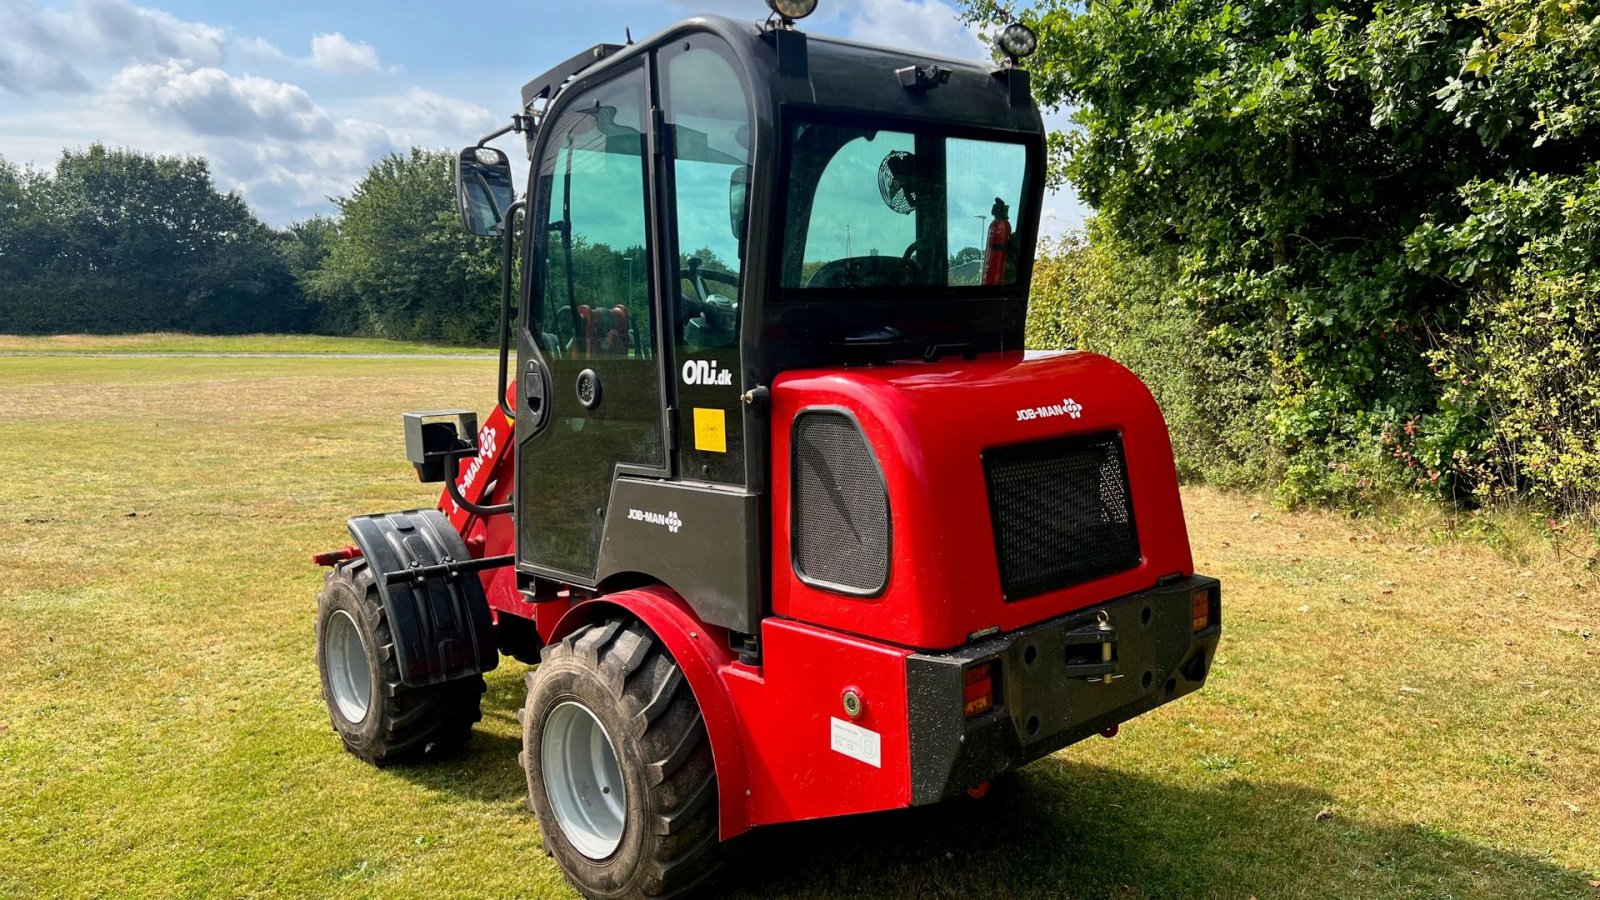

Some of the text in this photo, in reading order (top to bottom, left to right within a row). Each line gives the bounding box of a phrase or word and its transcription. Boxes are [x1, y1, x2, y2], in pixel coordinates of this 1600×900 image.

[1016, 404, 1064, 421] JOB-MAN
[451, 453, 484, 514] JB-MAN
[627, 508, 665, 525] JOB-MAN
